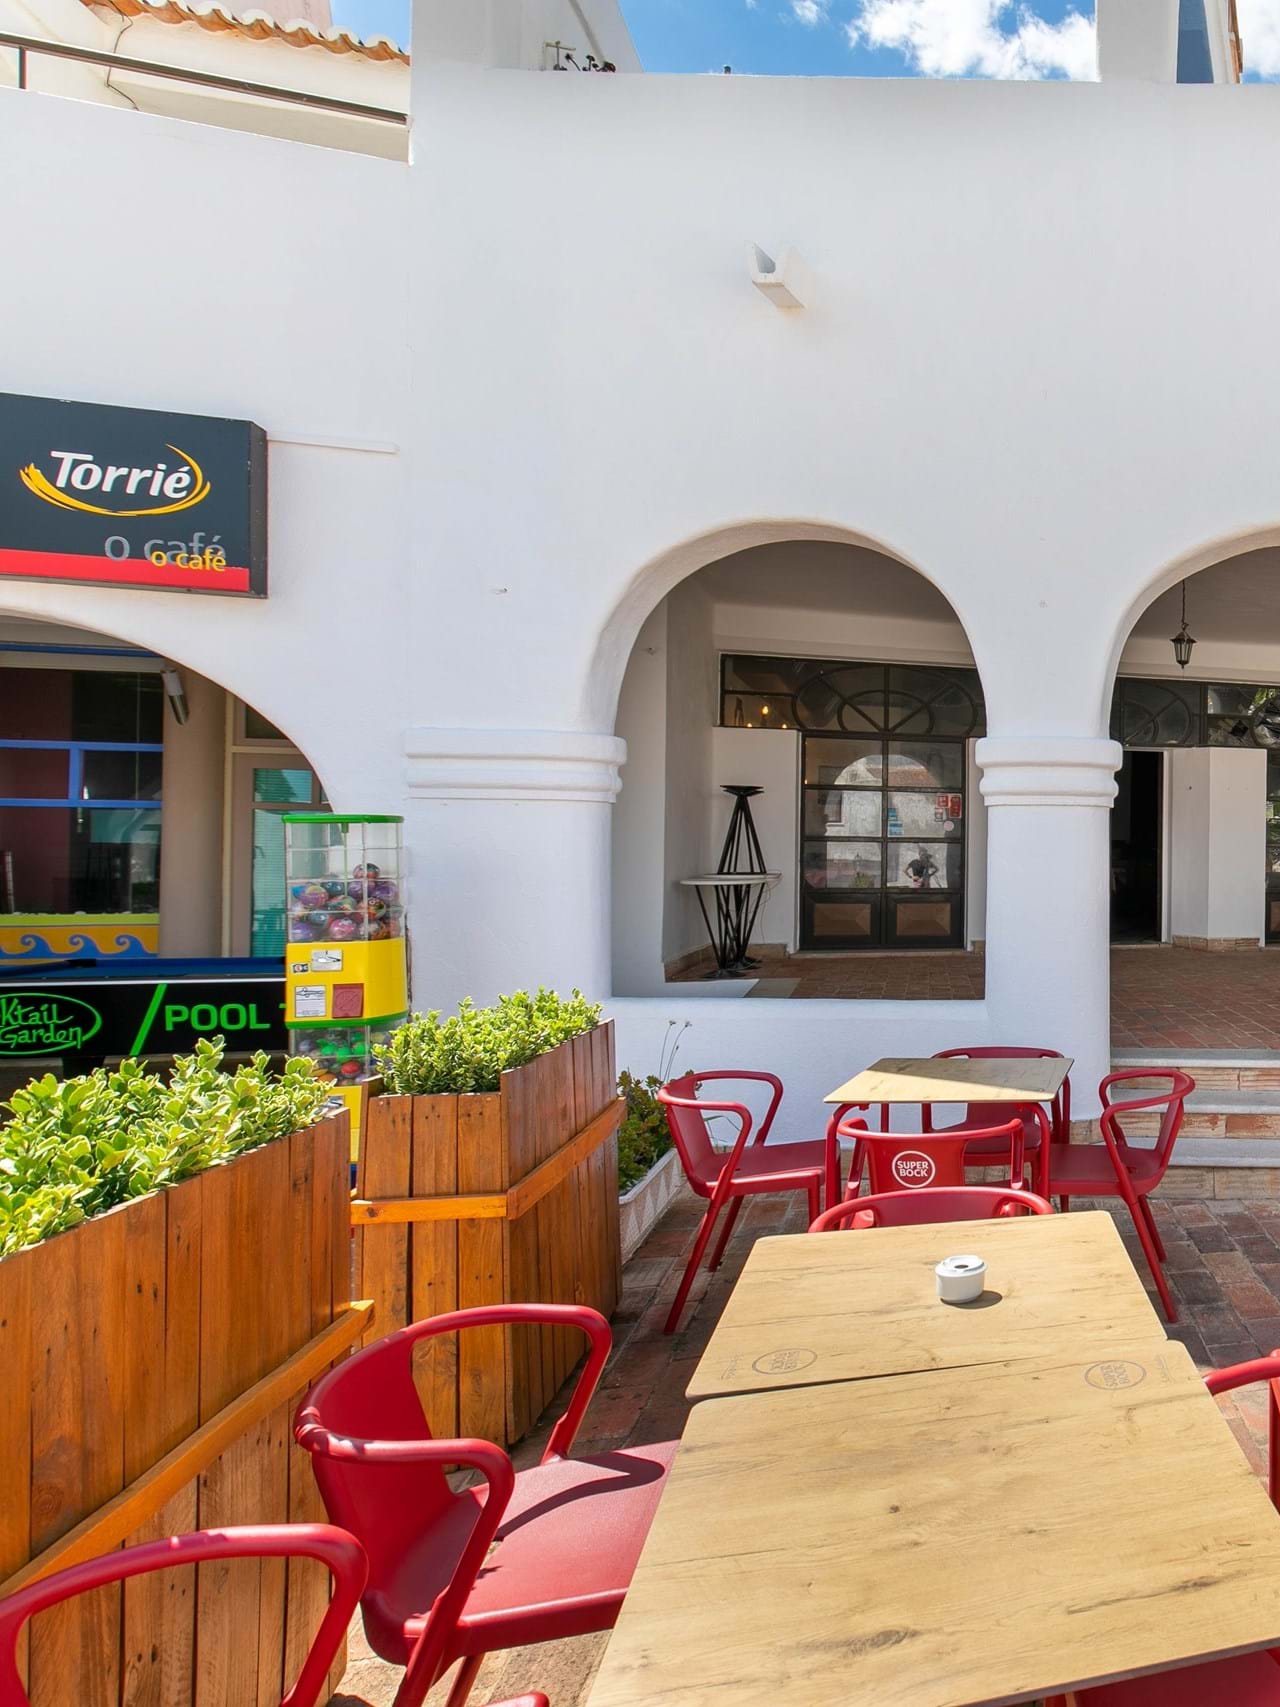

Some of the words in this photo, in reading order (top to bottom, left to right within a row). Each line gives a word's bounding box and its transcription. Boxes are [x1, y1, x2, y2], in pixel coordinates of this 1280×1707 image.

[50, 450, 191, 499] Torrié
[175, 547, 227, 572] café
[164, 1003, 271, 1032] POOL
[0, 1023, 82, 1049] Garden
[896, 1160, 929, 1169] SUPER
[899, 1168, 928, 1177] BOCK
